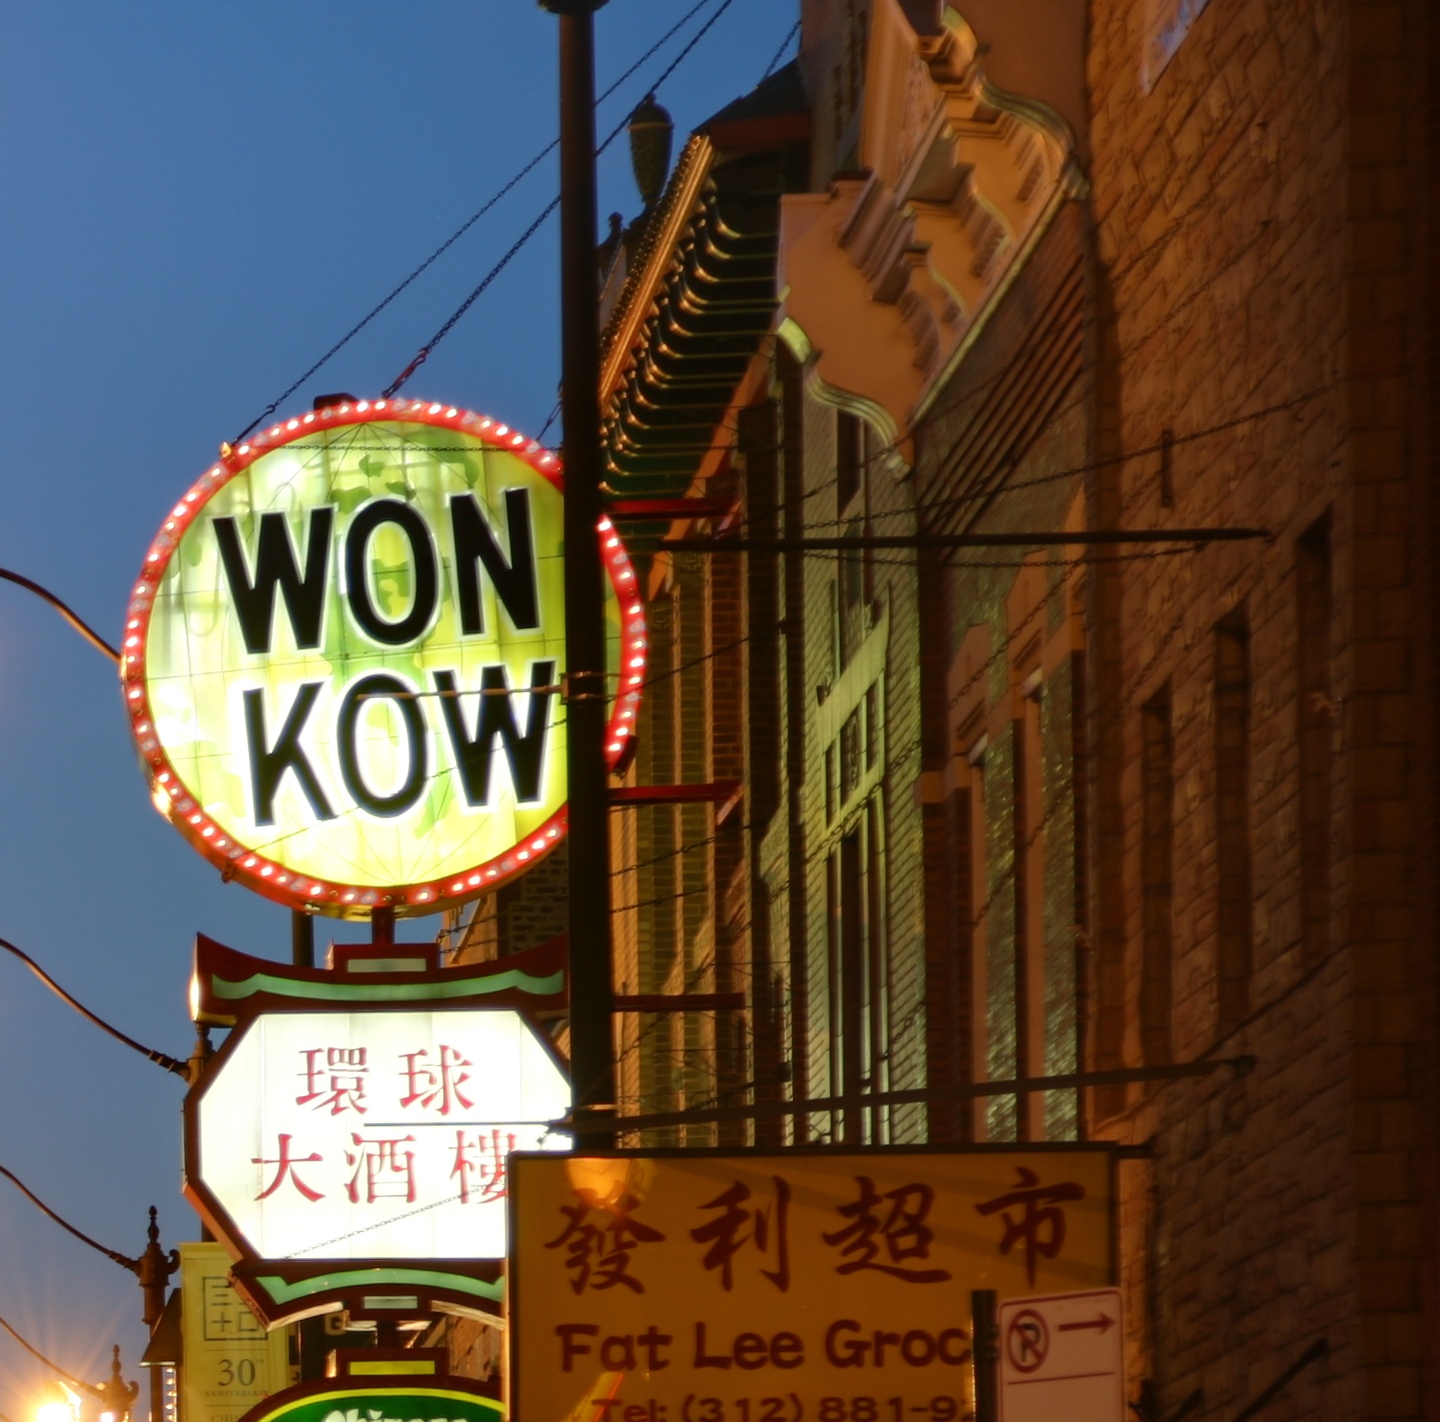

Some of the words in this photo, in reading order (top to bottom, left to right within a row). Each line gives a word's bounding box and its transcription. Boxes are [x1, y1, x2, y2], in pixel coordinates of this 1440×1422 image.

[212, 488, 540, 655] WON
[243, 660, 556, 827] KOW
[295, 1044, 474, 1116] 環球
[545, 1166, 1085, 1297] 發利超市
[556, 1323, 673, 1373] Fat
[693, 1322, 805, 1370] Lee
